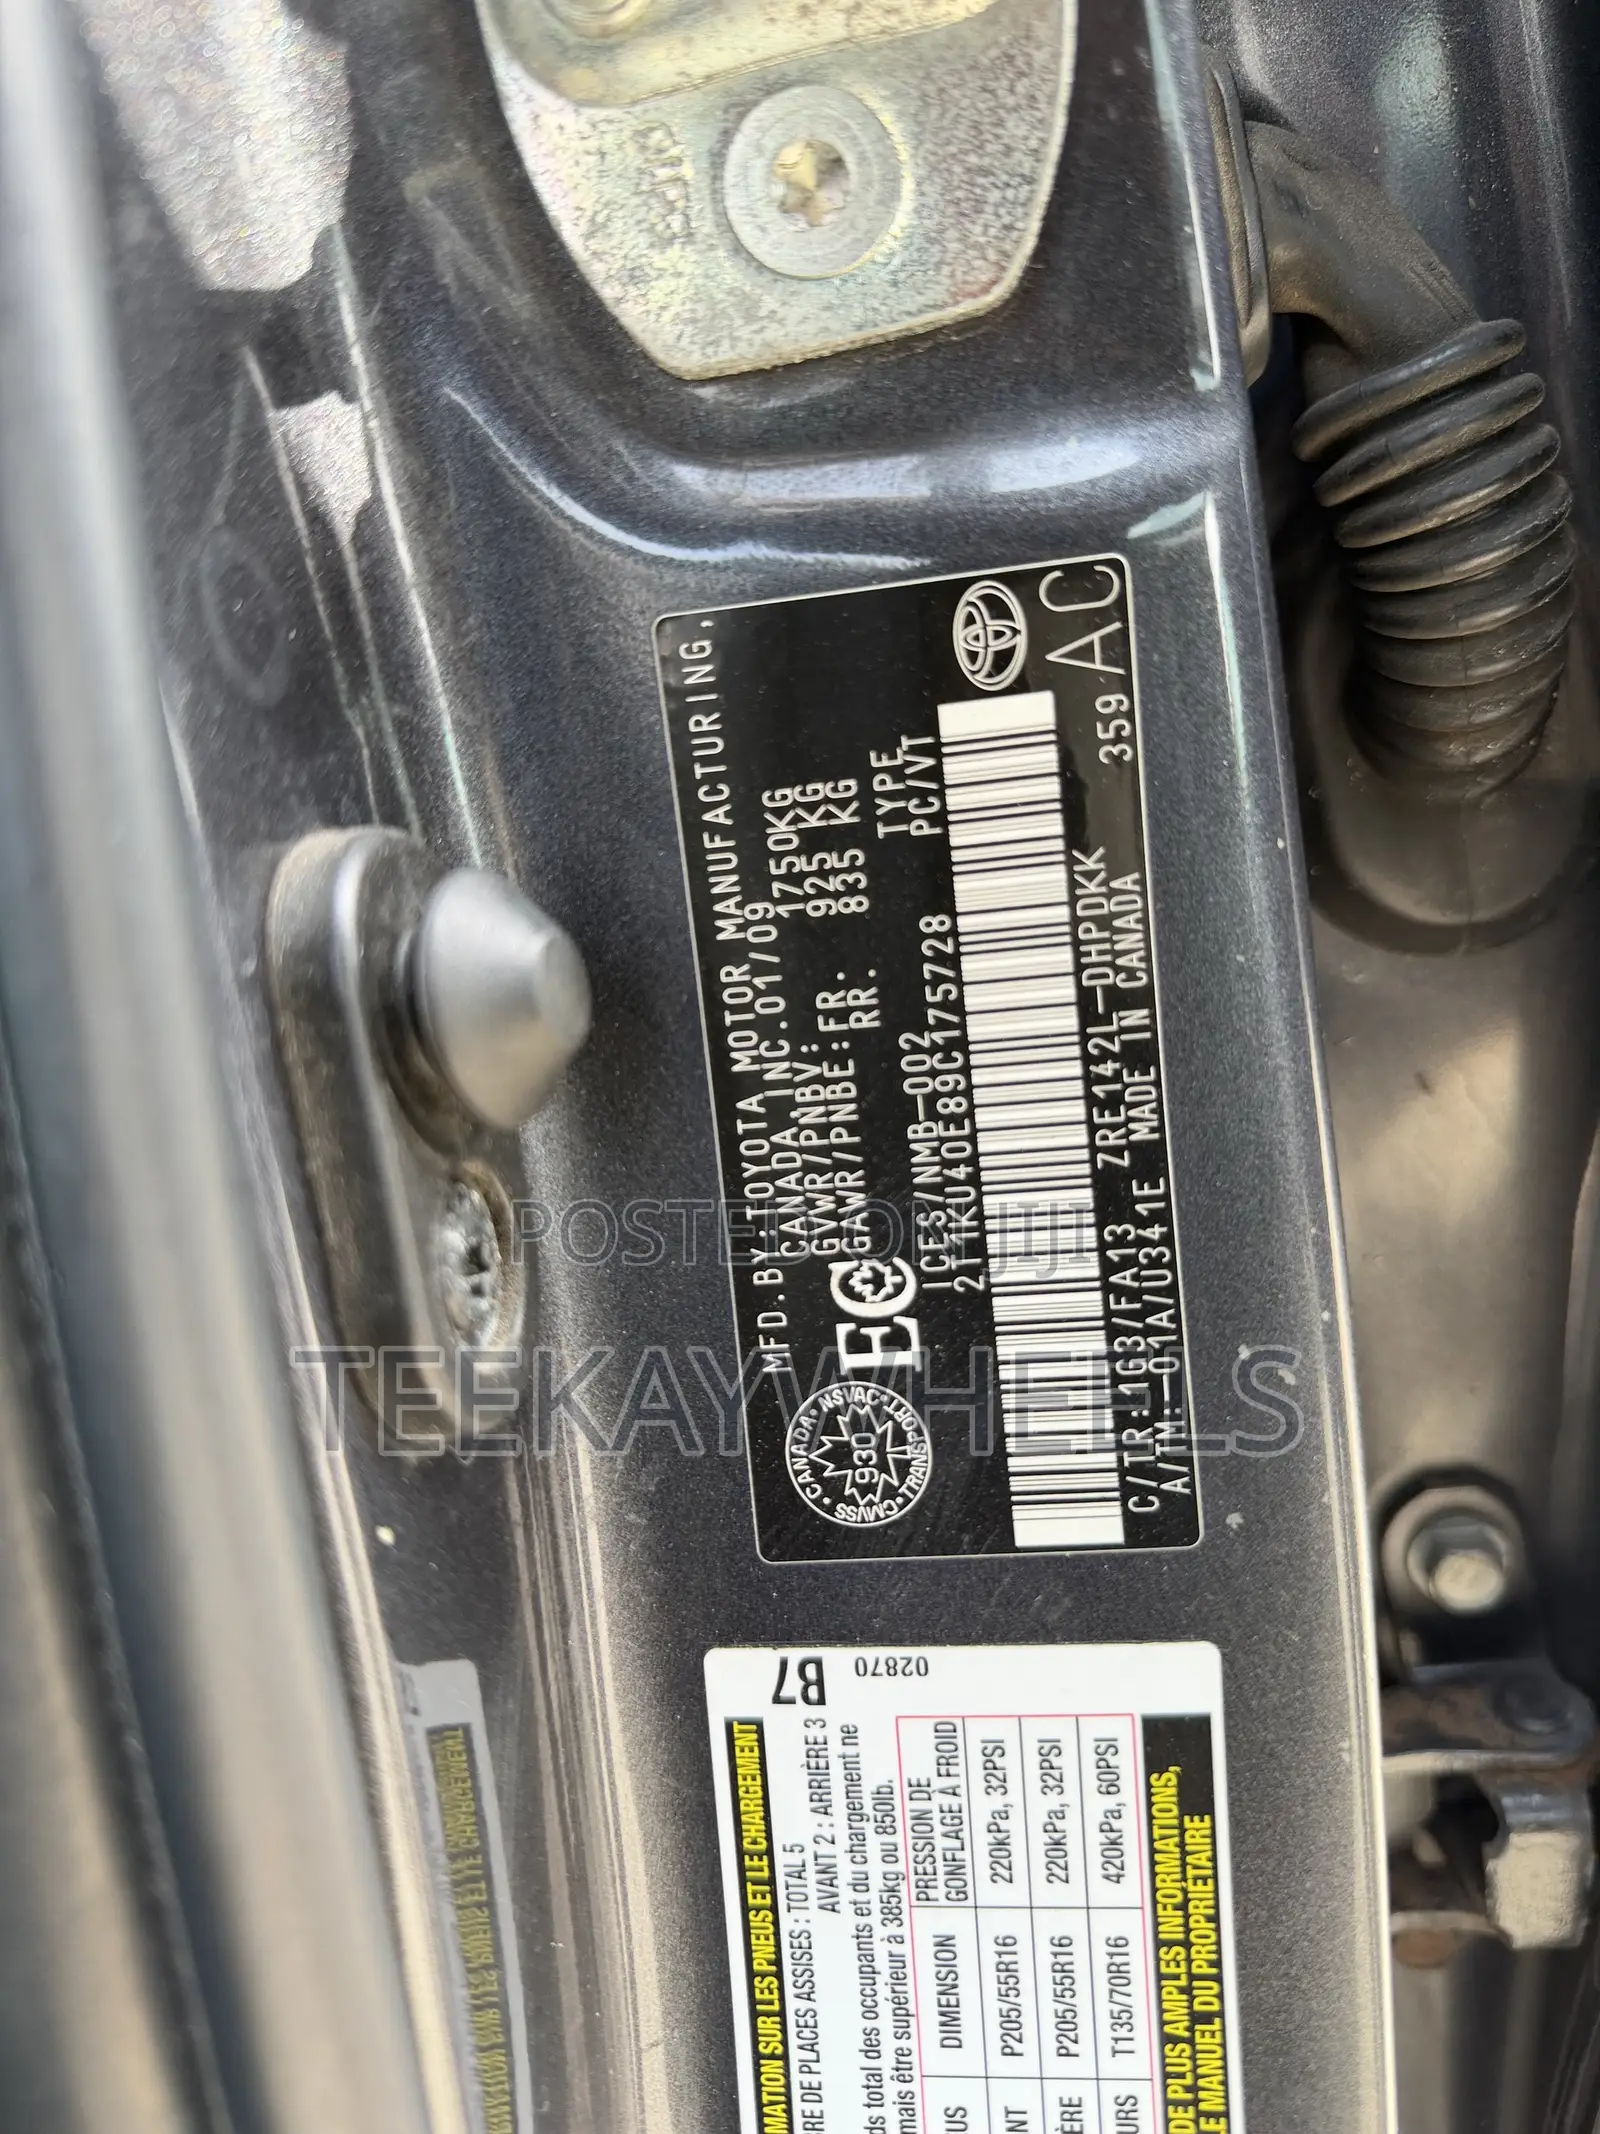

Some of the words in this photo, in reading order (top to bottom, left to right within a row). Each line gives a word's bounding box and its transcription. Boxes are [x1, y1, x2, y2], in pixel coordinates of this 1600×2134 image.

[1038, 565, 1126, 675] AC
[1094, 693, 1133, 765] 359
[679, 620, 745, 940] MANUFACTURING,
[793, 782, 829, 829] KG
[824, 778, 861, 825] KG
[869, 746, 909, 839] TYPE
[900, 735, 944, 836] PC/VT
[800, 851, 838, 917] 925
[832, 848, 869, 914] 835
[1108, 872, 1149, 989] CANADA
[720, 963, 761, 1072] MOTOR
[847, 968, 881, 1029] RR.
[1072, 846, 1131, 1170] ZRE142L-DHPDKK
[1118, 1008, 1152, 1040] IN
[918, 913, 986, 1293] 2T1KU40E89C175728
[1122, 1065, 1160, 1142] MADE
[792, 1044, 840, 1255] GVWR/PNBV:
[898, 1030, 952, 1289] ICES/NMB-002
[817, 1386, 881, 1413] NSVAC
[790, 1415, 822, 1499] CANADA
[850, 1433, 879, 1484] 930
[883, 1399, 928, 1500] TRANSPORT
[834, 1499, 899, 1523] CMVSS
[771, 1656, 826, 1706] B7
[854, 1656, 929, 1677] 02870
[804, 1718, 827, 1729] 3
[839, 1724, 858, 1746] ne
[933, 1721, 960, 1778] FROID
[733, 1721, 767, 1850] CHARGEMENT
[801, 1734, 833, 1817] ARRIÈRE
[907, 1777, 932, 1802] DE
[931, 1784, 961, 1798] À
[980, 1739, 1007, 1796] 32PSI
[1037, 1738, 1064, 1796] 32PSI
[1093, 1737, 1121, 1795] 60PSI
[838, 1752, 870, 1865] chargement
[870, 1779, 898, 1835] 850lb.
[744, 1855, 770, 1877] LE
[782, 1843, 805, 1853] 5
[813, 1834, 836, 1845] 2
[880, 1842, 900, 1864] ou
[909, 1808, 939, 1902] PRESSION
[938, 1803, 969, 1902] GONFLAGE
[986, 1803, 1014, 1884] 220kPa,
[1042, 1803, 1070, 1884] 220kPa,
[1099, 1802, 1127, 1884] 420kPa,
[1149, 1766, 1184, 1939] INFORMATIONS,
[746, 1881, 772, 1906] ET
[784, 1859, 810, 1912] TOTAL
[813, 1851, 841, 1914] AVANT
[845, 1869, 869, 1893] du
[848, 1899, 871, 1917] et
[877, 1871, 905, 1928] 385kg
[1181, 1815, 1219, 1974] PROPRIÉTAIRE
[748, 1909, 777, 1972] PNEUS
[880, 1934, 905, 1945] à
[752, 1976, 781, 2011] LES
[850, 1924, 881, 2021] occupants
[885, 1950, 915, 2040] supérieur
[932, 1934, 963, 2049] DIMENSION
[993, 1935, 1025, 2057] P205/55R16
[1050, 1936, 1080, 2058] P205/55R16
[1105, 1936, 1136, 2058] T135/70R16
[1158, 1946, 1192, 2037] AMPLES
[1191, 1979, 1221, 2012] DU
[755, 2016, 785, 2055] SUR
[794, 2008, 821, 2075] PLACES
[859, 2027, 882, 2060] des
[889, 2046, 914, 2084] être
[1193, 2017, 1227, 2112] MANUEL
[799, 2080, 823, 2103] DE
[859, 2067, 884, 2108] total
[1163, 2043, 1196, 2100] PLUS
[801, 2109, 825, 2134] RE
[943, 2106, 968, 2134] US
[1167, 2105, 1197, 2134] DE
